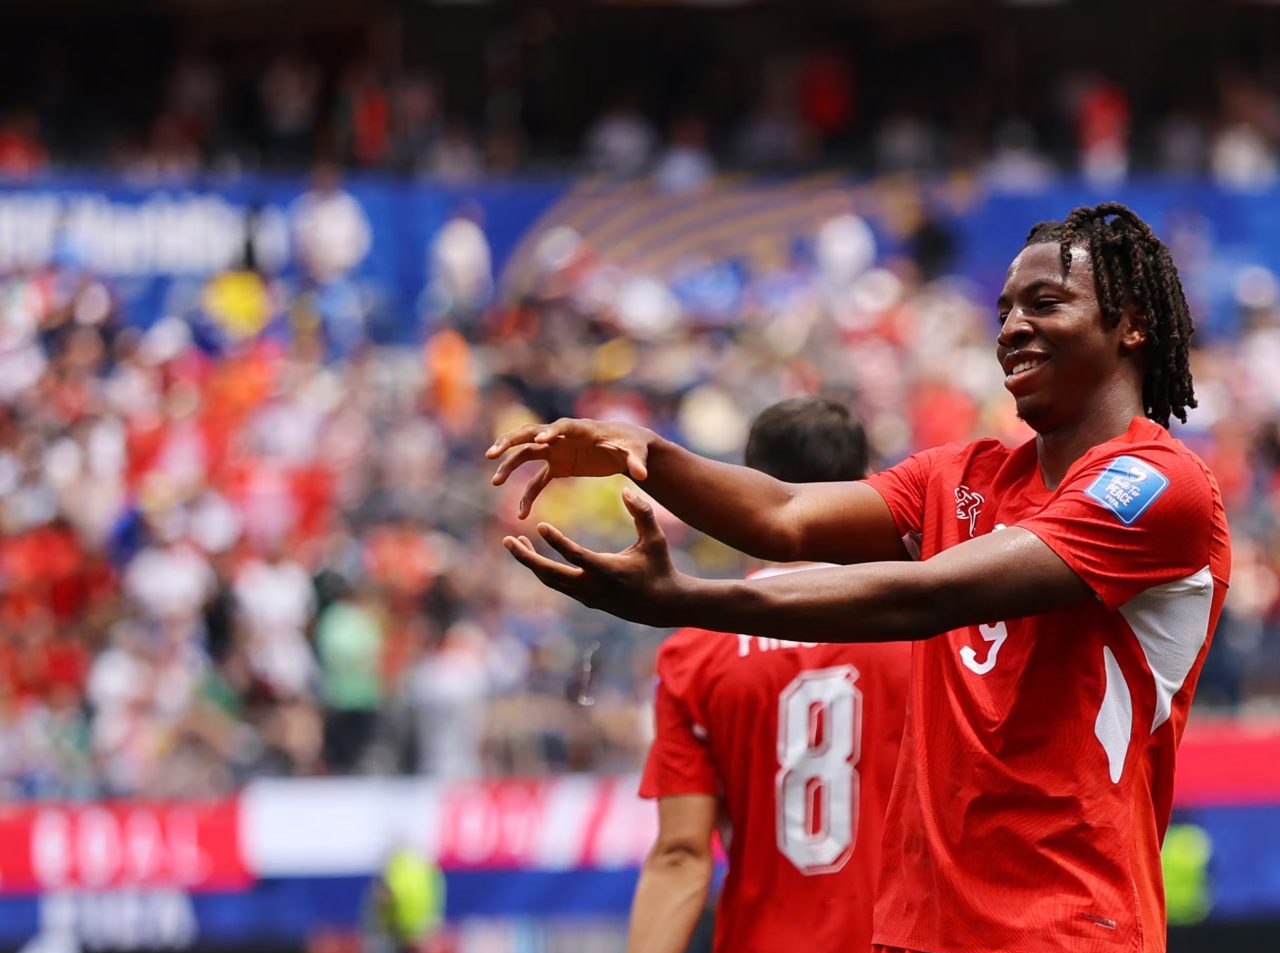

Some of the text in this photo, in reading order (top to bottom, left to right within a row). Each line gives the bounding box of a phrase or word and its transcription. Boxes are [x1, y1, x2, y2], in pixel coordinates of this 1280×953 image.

[1105, 482, 1133, 507] PEACE
[959, 620, 1008, 675] 9
[775, 663, 863, 876] 8
